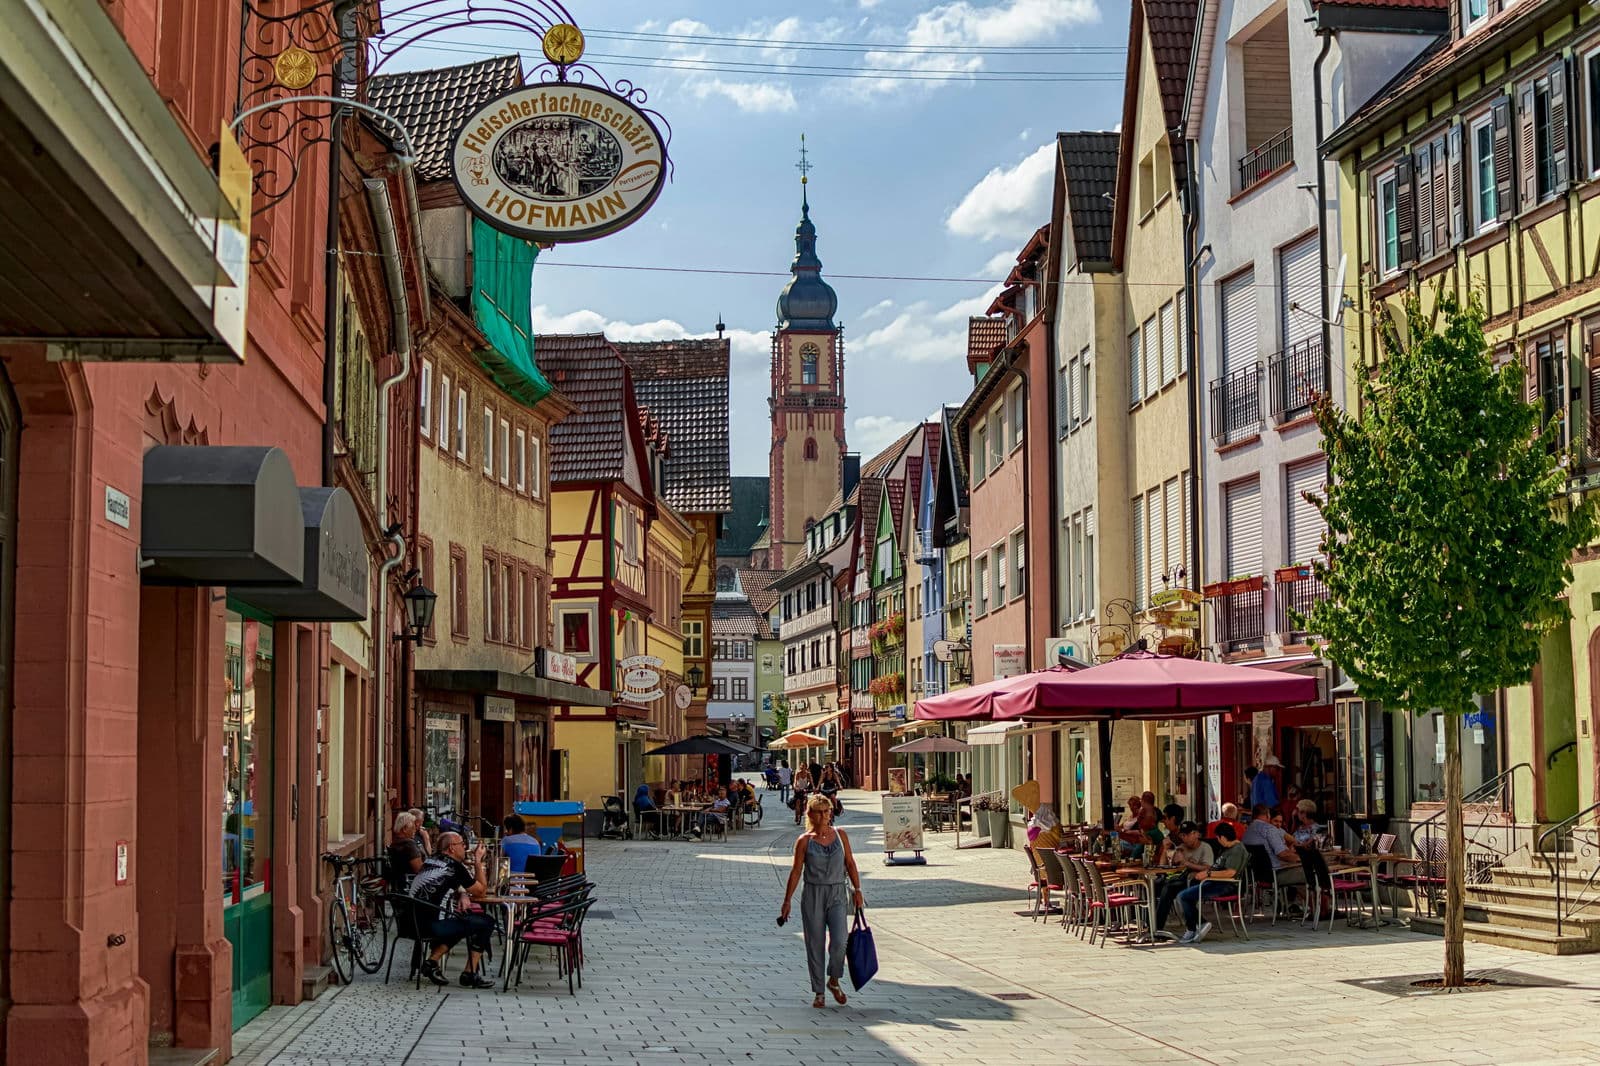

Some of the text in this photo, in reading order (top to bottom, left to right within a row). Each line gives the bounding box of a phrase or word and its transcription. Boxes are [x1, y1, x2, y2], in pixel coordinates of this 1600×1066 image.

[463, 93, 654, 154] Fleischerfachgeschäft
[619, 169, 654, 186] Partyservice
[486, 189, 628, 228] HOFMANN
